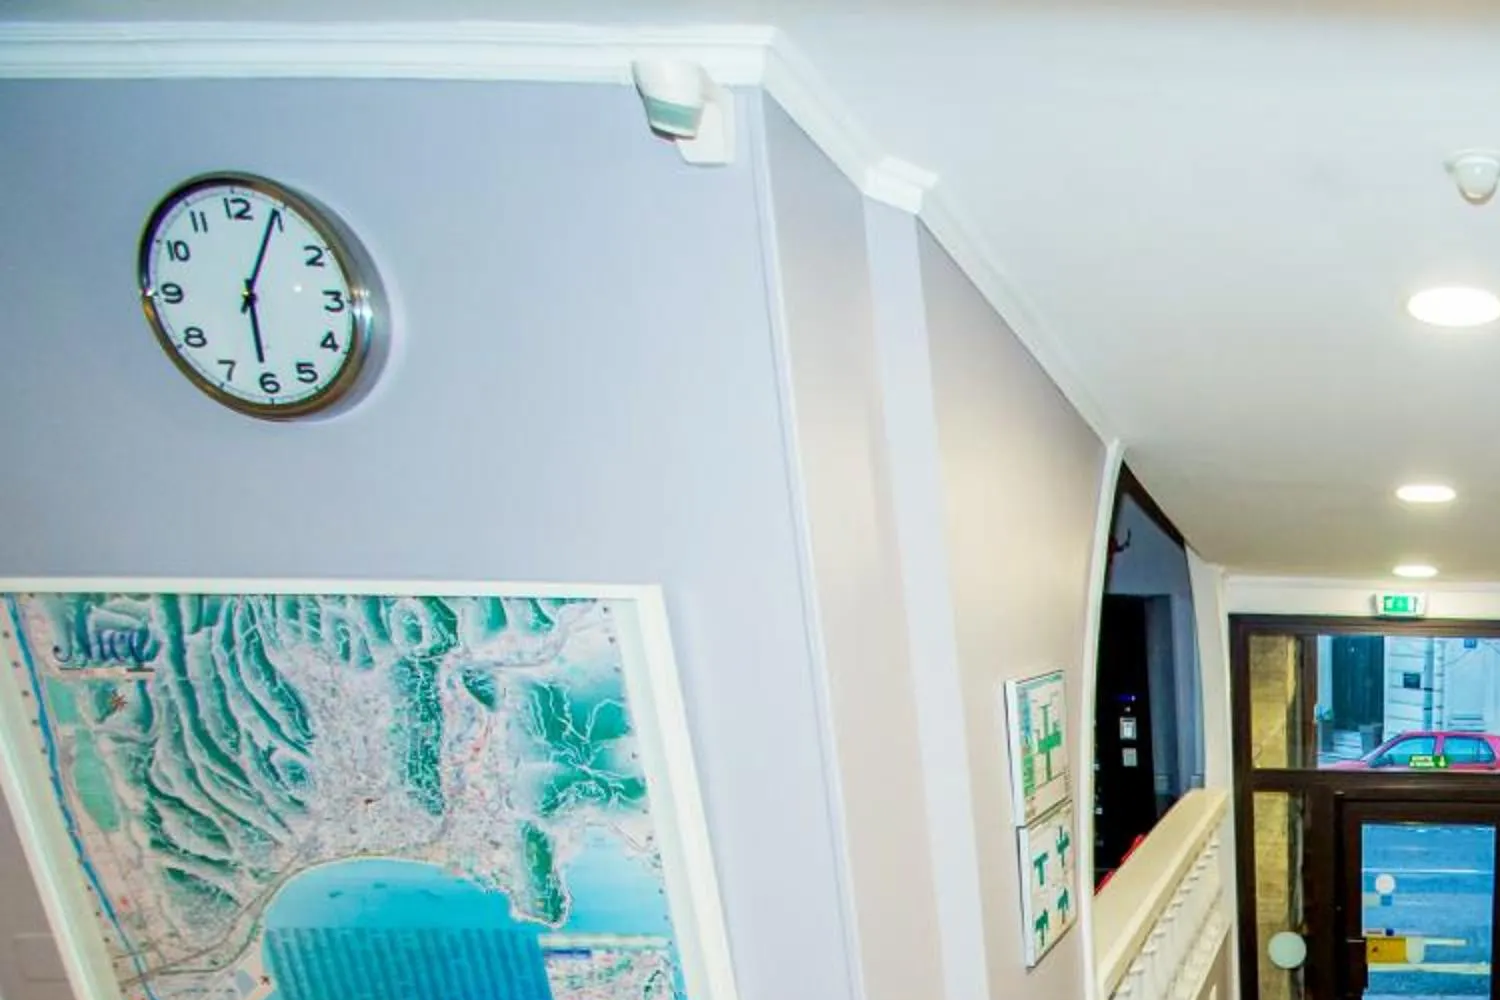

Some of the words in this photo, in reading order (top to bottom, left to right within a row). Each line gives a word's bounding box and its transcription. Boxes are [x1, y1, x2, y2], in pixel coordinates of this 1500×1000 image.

[224, 198, 253, 220] 12
[190, 211, 208, 233] 11
[167, 240, 190, 262] 10
[303, 245, 324, 267] 2
[161, 283, 183, 304] 9
[322, 290, 344, 312] 3
[183, 327, 207, 348] 8
[320, 332, 340, 352] 4
[218, 360, 236, 381] 7
[296, 363, 318, 383] 5
[259, 373, 280, 394] 6
